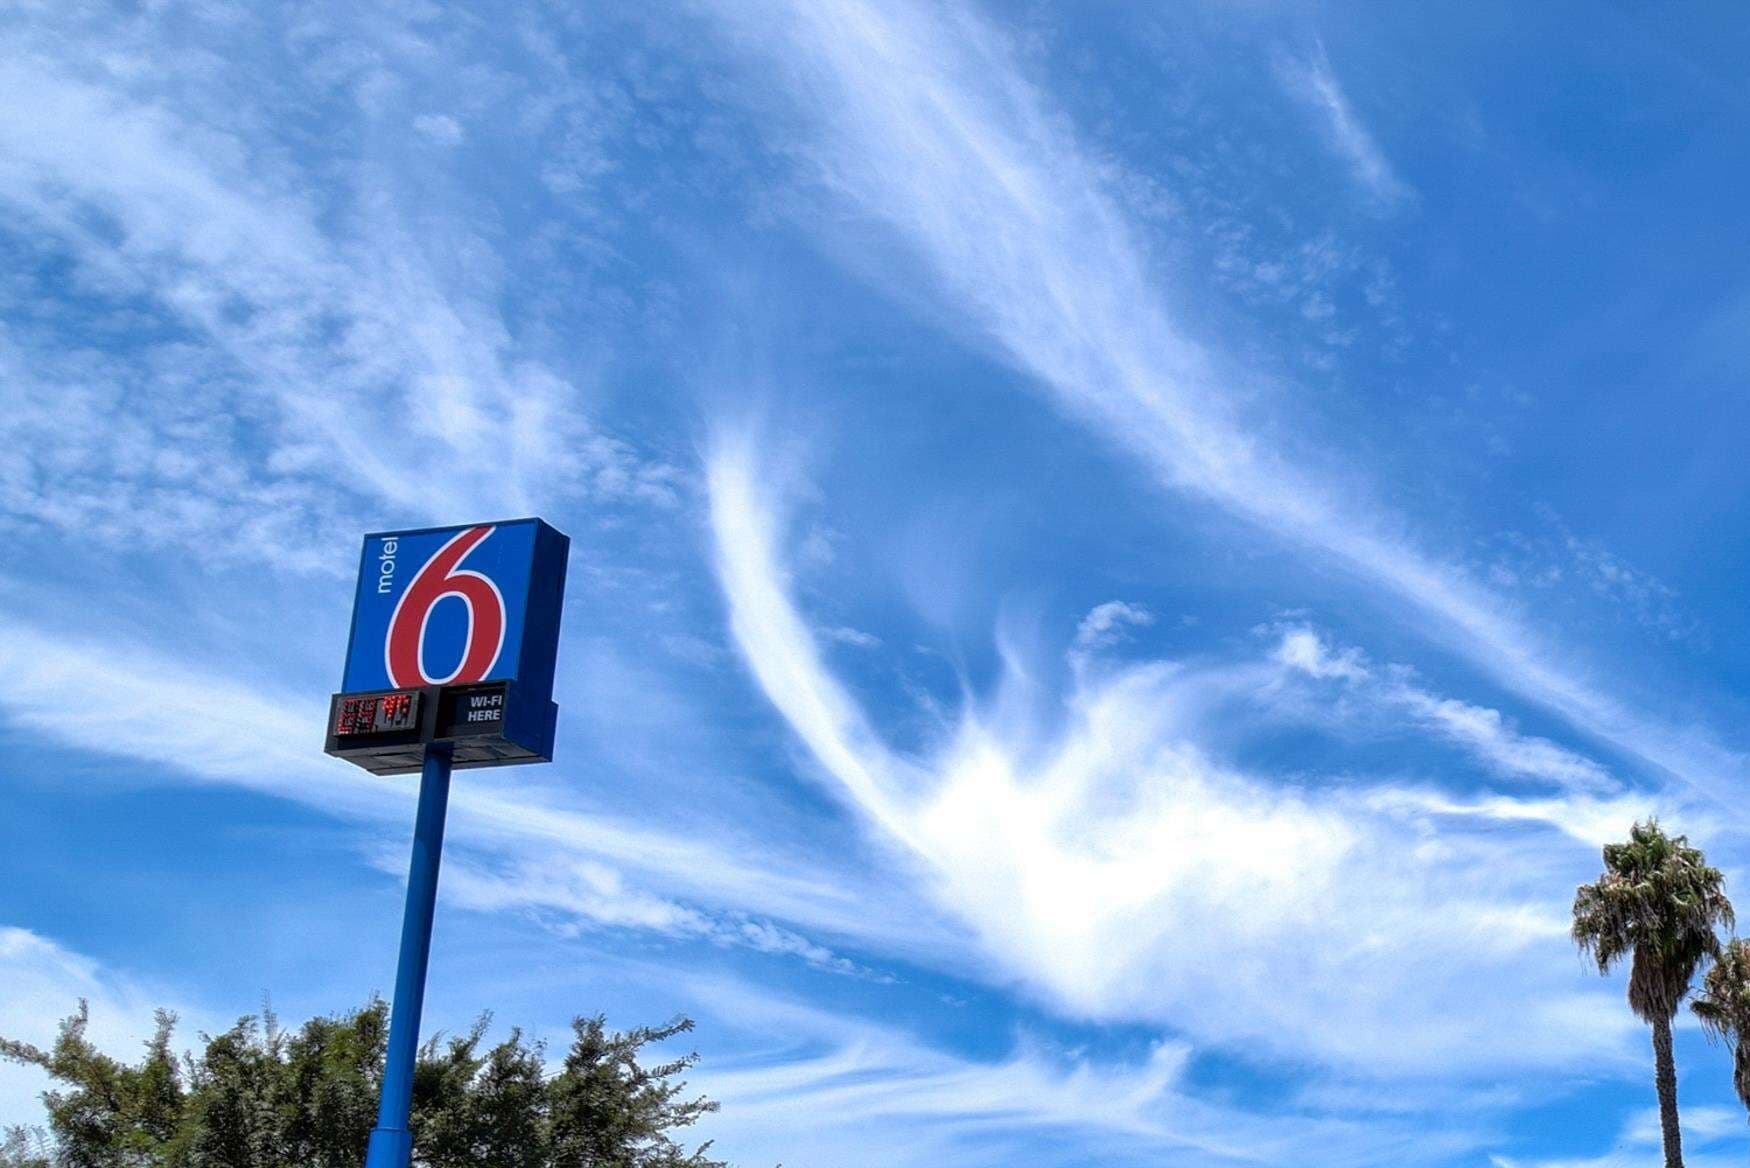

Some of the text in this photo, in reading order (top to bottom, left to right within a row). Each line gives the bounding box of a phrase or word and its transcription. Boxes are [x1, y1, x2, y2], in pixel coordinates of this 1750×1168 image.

[378, 537, 398, 594] motel
[385, 525, 507, 689] 6
[468, 709, 501, 722] HERE
[471, 695, 502, 708] WI-FI
